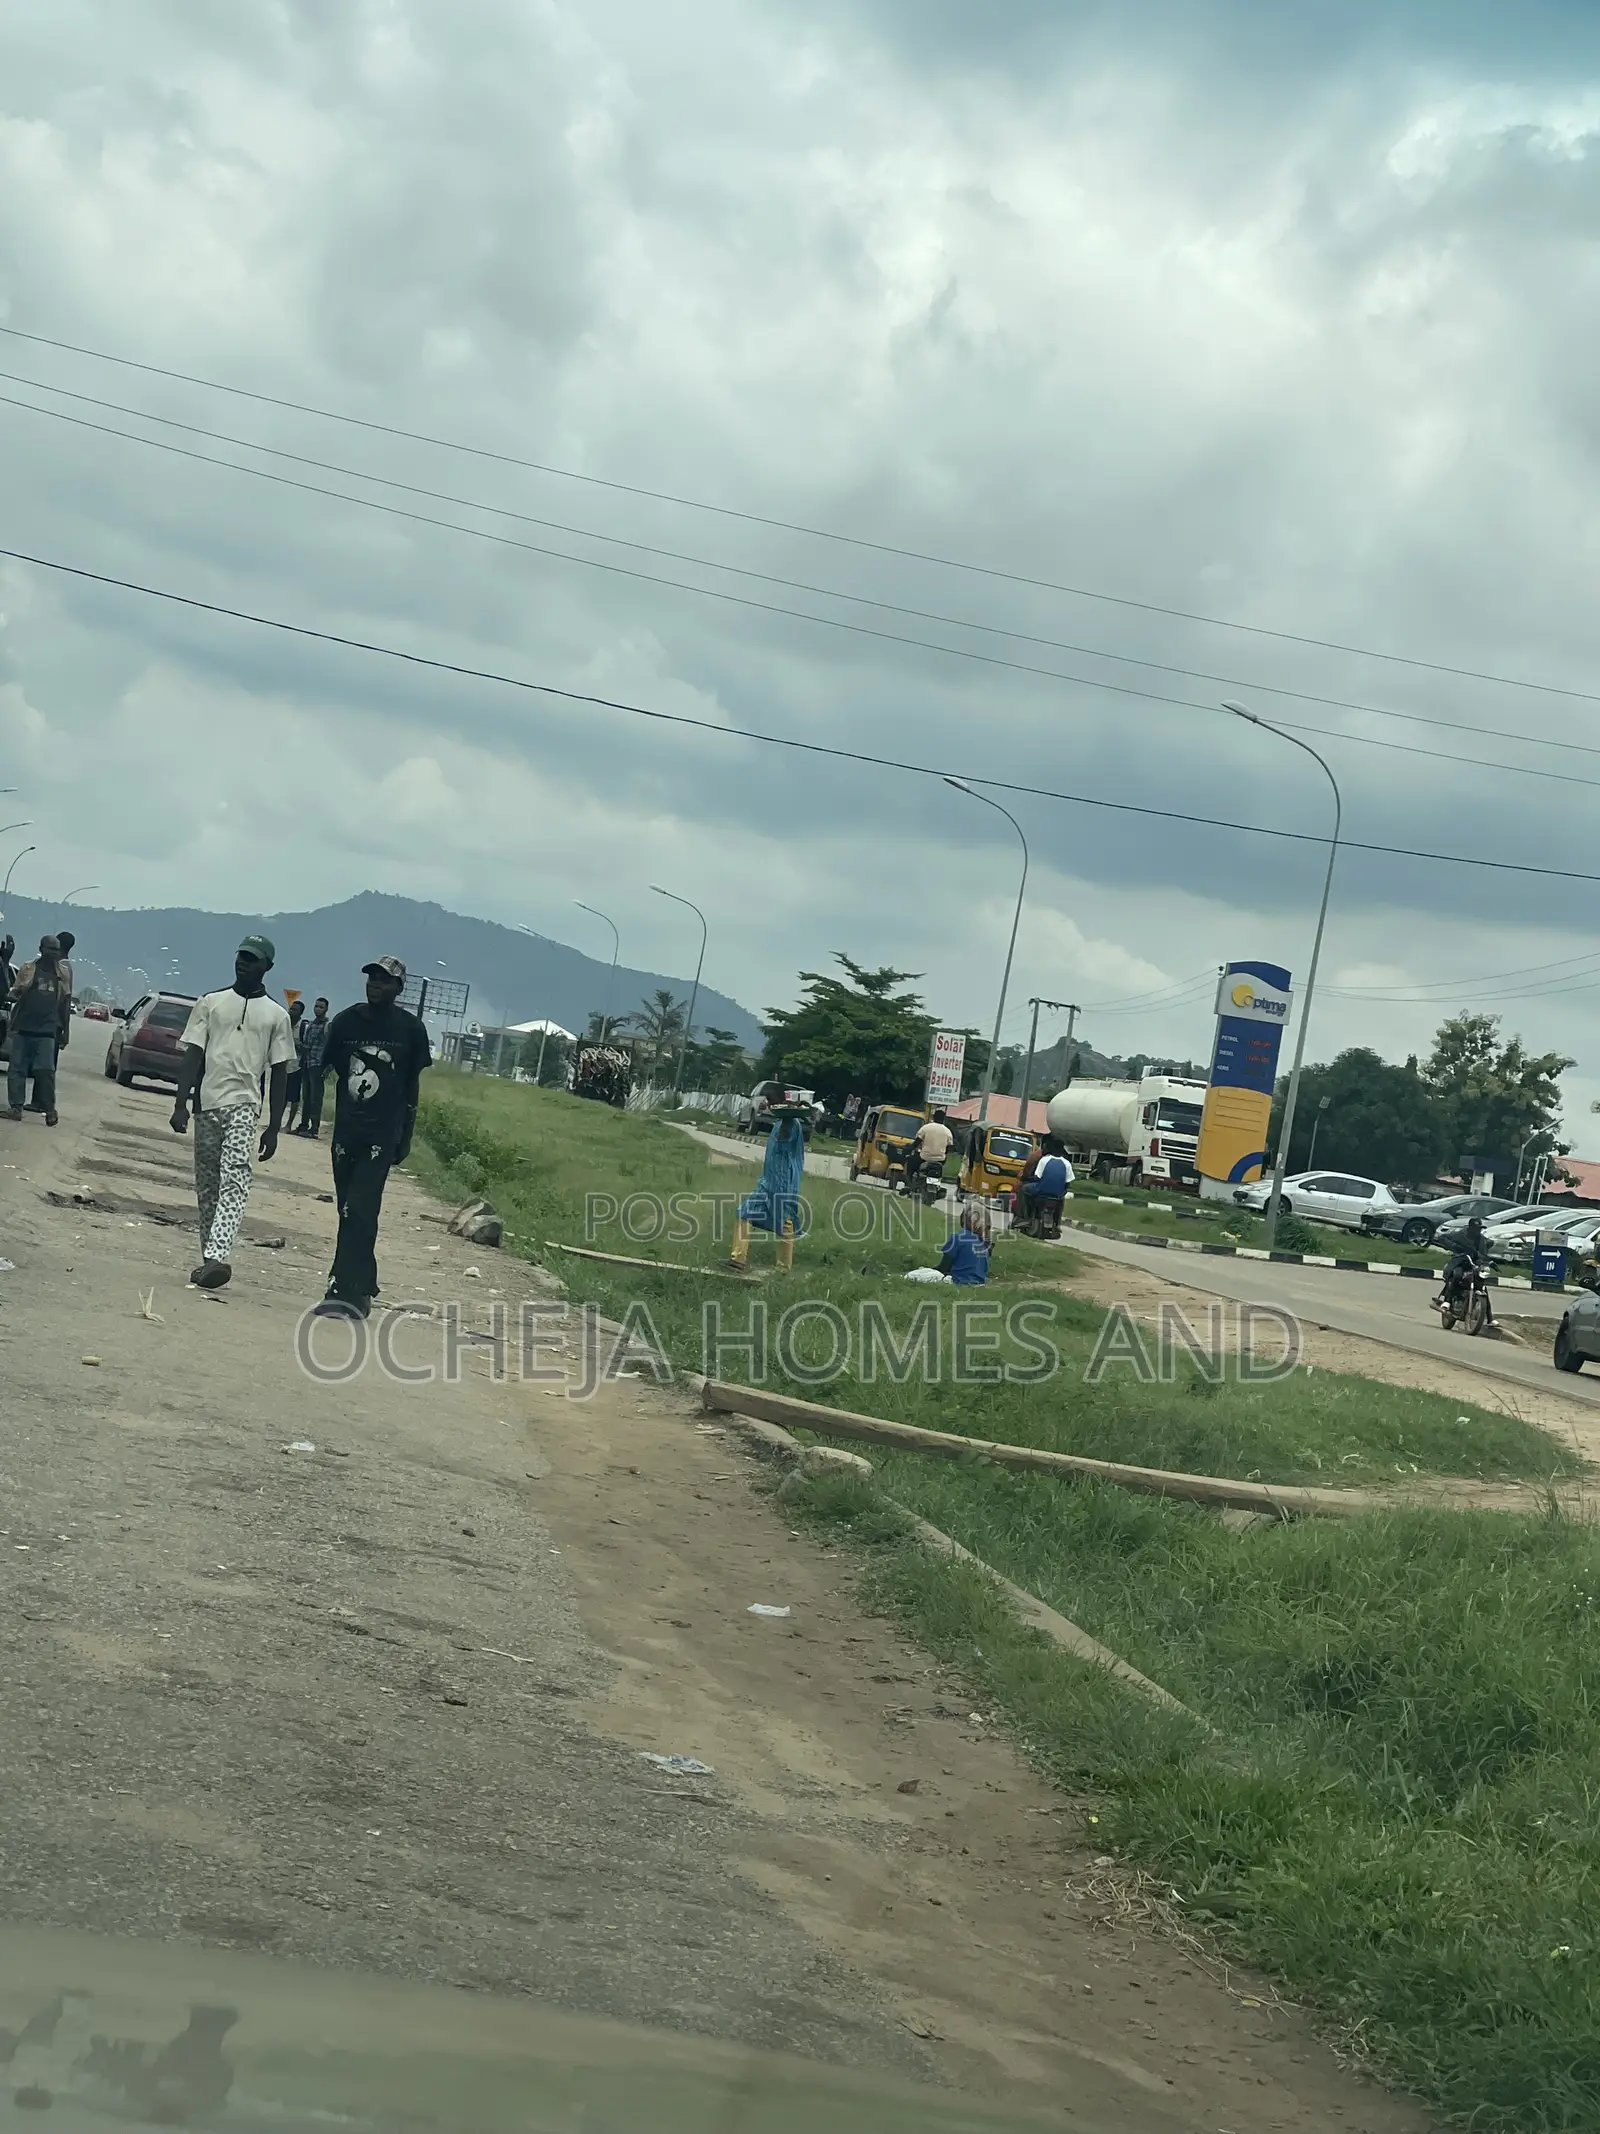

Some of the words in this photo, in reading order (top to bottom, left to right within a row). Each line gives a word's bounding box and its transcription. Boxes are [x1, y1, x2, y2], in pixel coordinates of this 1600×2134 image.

[1232, 985, 1287, 1012] Optima
[937, 1035, 964, 1053] Solar
[1221, 1035, 1239, 1043] PETROL
[933, 1053, 962, 1071] Inverter
[931, 1071, 960, 1092] Battery
[1546, 1261, 1555, 1271] IN
